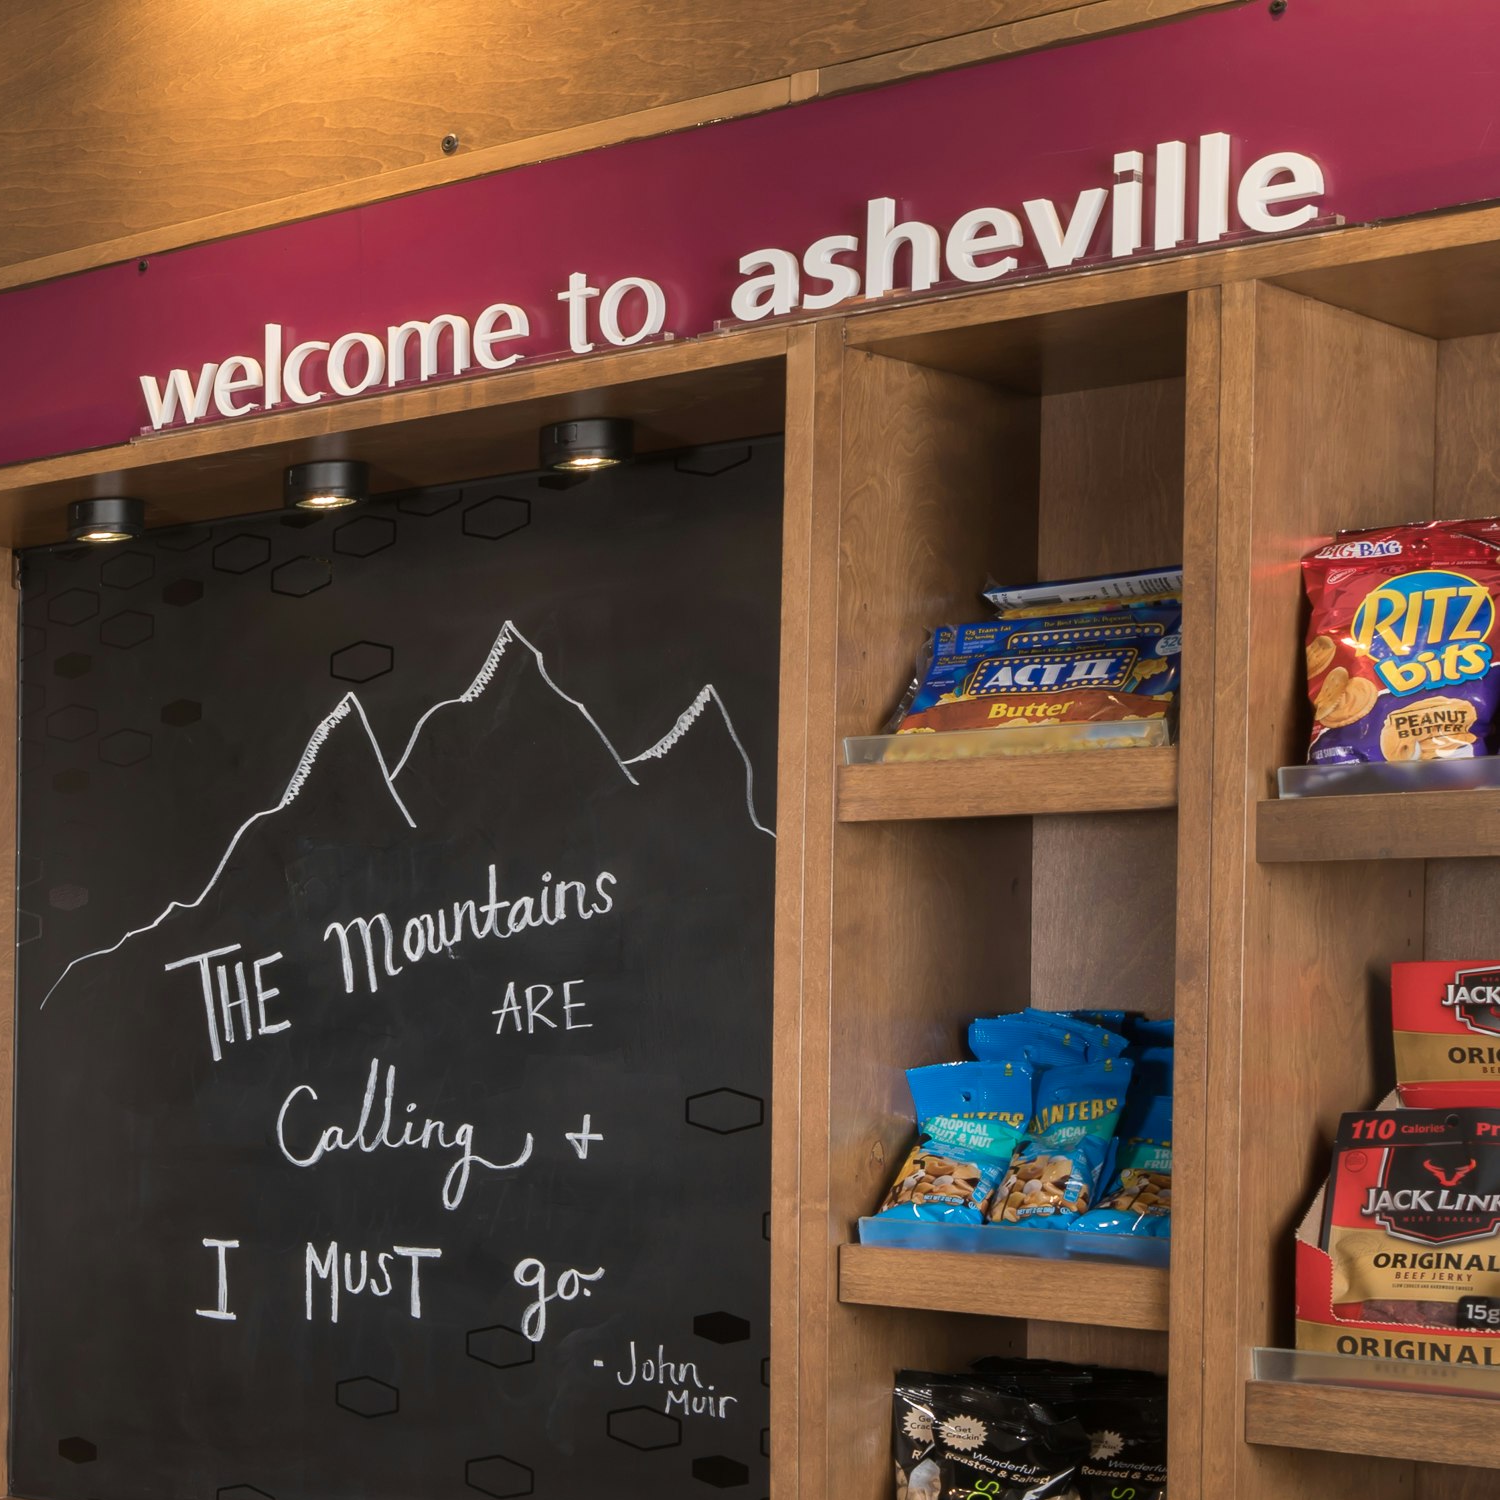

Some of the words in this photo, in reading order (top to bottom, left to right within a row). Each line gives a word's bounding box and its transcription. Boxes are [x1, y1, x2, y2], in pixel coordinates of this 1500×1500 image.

[139, 301, 532, 430] welcome
[557, 271, 666, 354] to
[730, 133, 1327, 321] asheville
[1316, 543, 1357, 559] BIG
[1359, 541, 1401, 556] BAG
[1356, 587, 1489, 657] RITZ
[984, 663, 1066, 688] ACT
[1066, 658, 1116, 682] II
[1380, 643, 1486, 692] bits
[988, 701, 1074, 719] Butter
[1394, 711, 1467, 729] PEANUT
[1398, 724, 1465, 739] BUTTER
[165, 945, 291, 1062] THE
[493, 979, 594, 1034] ARE
[277, 1059, 533, 1209] Calling
[934, 1116, 989, 1136] TROPICAL
[1352, 1120, 1396, 1140] 110
[1401, 1124, 1445, 1134] Calories
[969, 1134, 994, 1148] NUT
[1362, 1188, 1436, 1215] JACK
[1373, 1253, 1500, 1272] ORIGINAL
[196, 1239, 240, 1319] I
[306, 1241, 441, 1322] MUST
[1395, 1272, 1425, 1280] BEEF
[1432, 1273, 1473, 1282] JERKY
[618, 1341, 704, 1387] John
[1336, 1335, 1500, 1366] ORIGINAL
[665, 1389, 737, 1417] Muir
[973, 1451, 1037, 1474] Wonderful
[1081, 1465, 1128, 1478] Roasted
